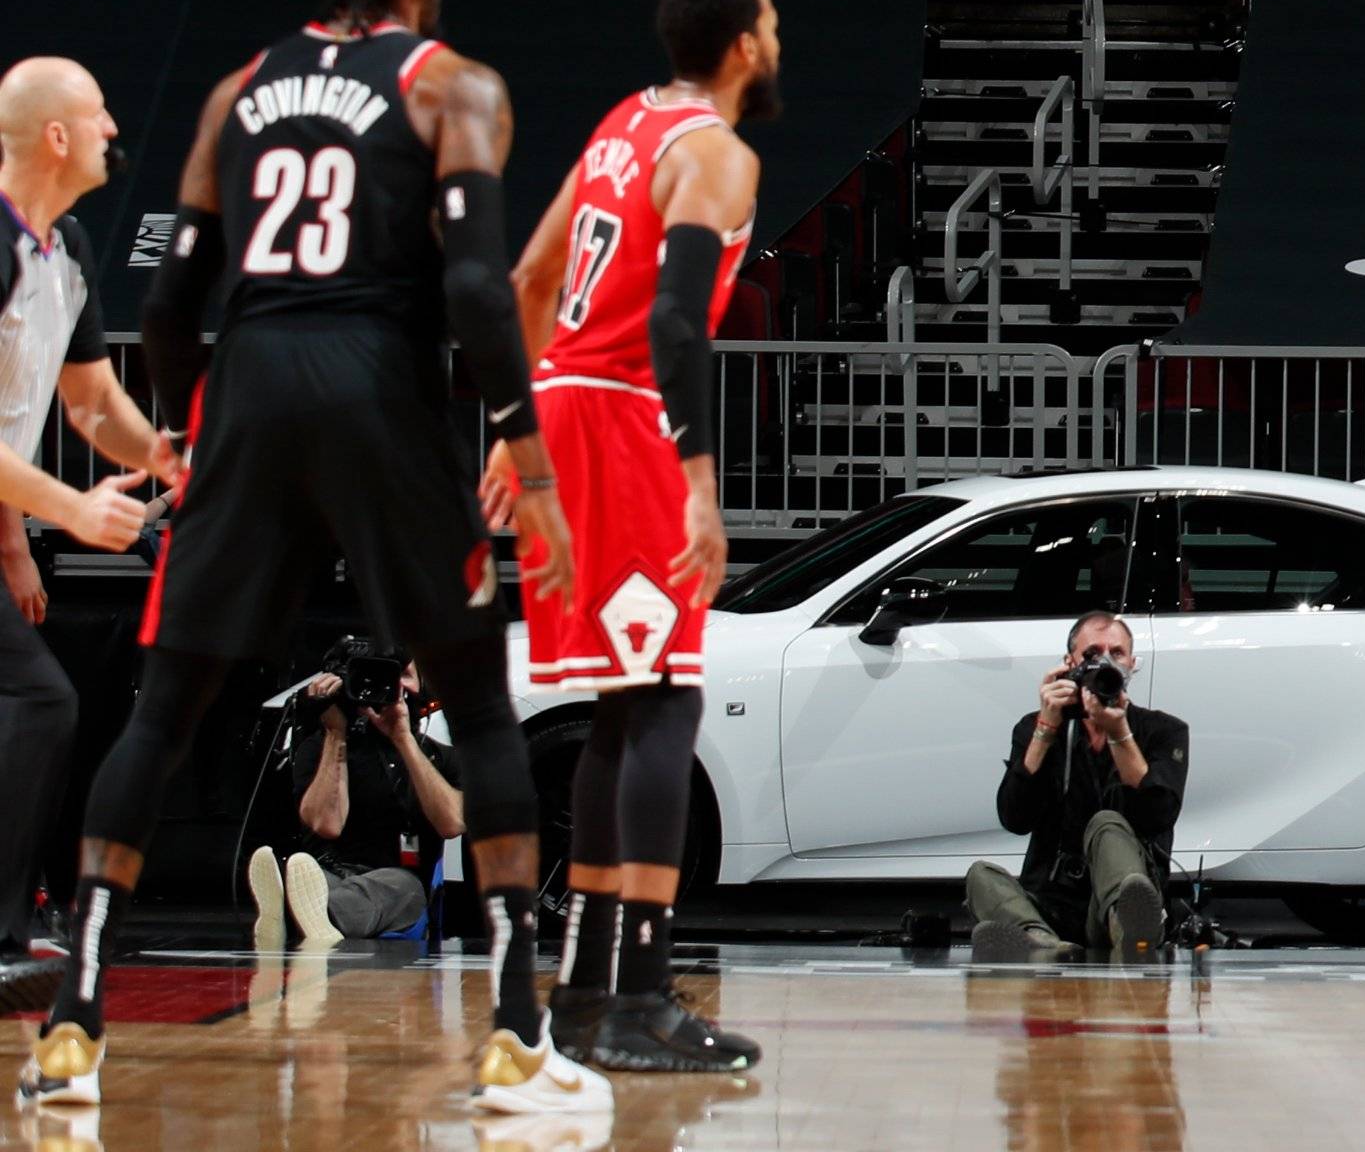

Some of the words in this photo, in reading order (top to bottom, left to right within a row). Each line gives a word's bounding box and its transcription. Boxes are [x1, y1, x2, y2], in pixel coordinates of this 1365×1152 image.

[236, 75, 389, 135] COVINGTON
[243, 146, 356, 274] 23
[558, 203, 622, 332] 17
